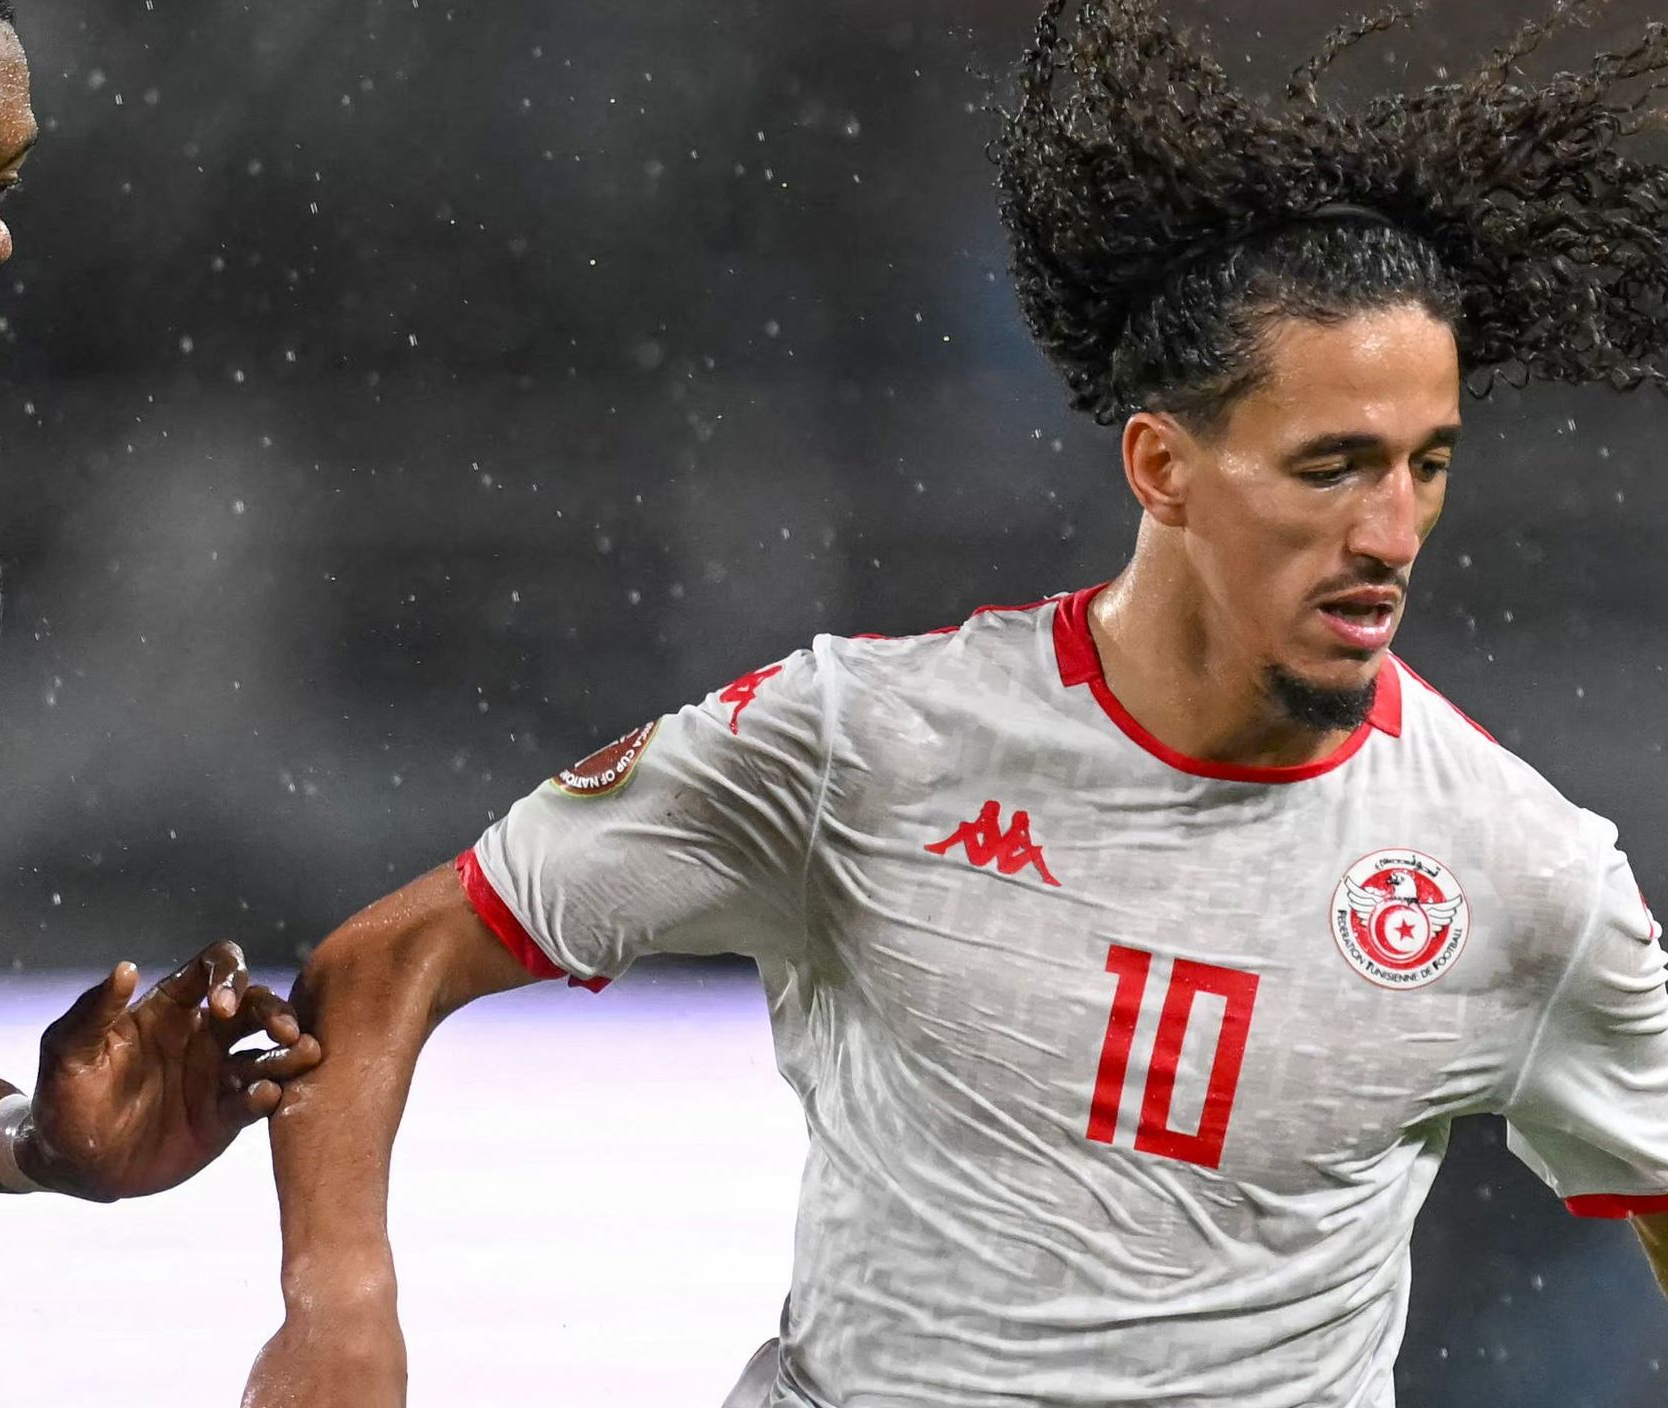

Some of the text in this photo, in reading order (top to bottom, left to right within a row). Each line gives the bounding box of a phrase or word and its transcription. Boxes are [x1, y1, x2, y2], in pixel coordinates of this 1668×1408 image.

[600, 769, 615, 785] OF
[616, 749, 635, 773] CUP
[1364, 960, 1419, 983] TUNISIENNE
[1421, 967, 1433, 979] DE
[1433, 928, 1463, 971] FOOTBALL
[1086, 944, 1260, 1169] 10
